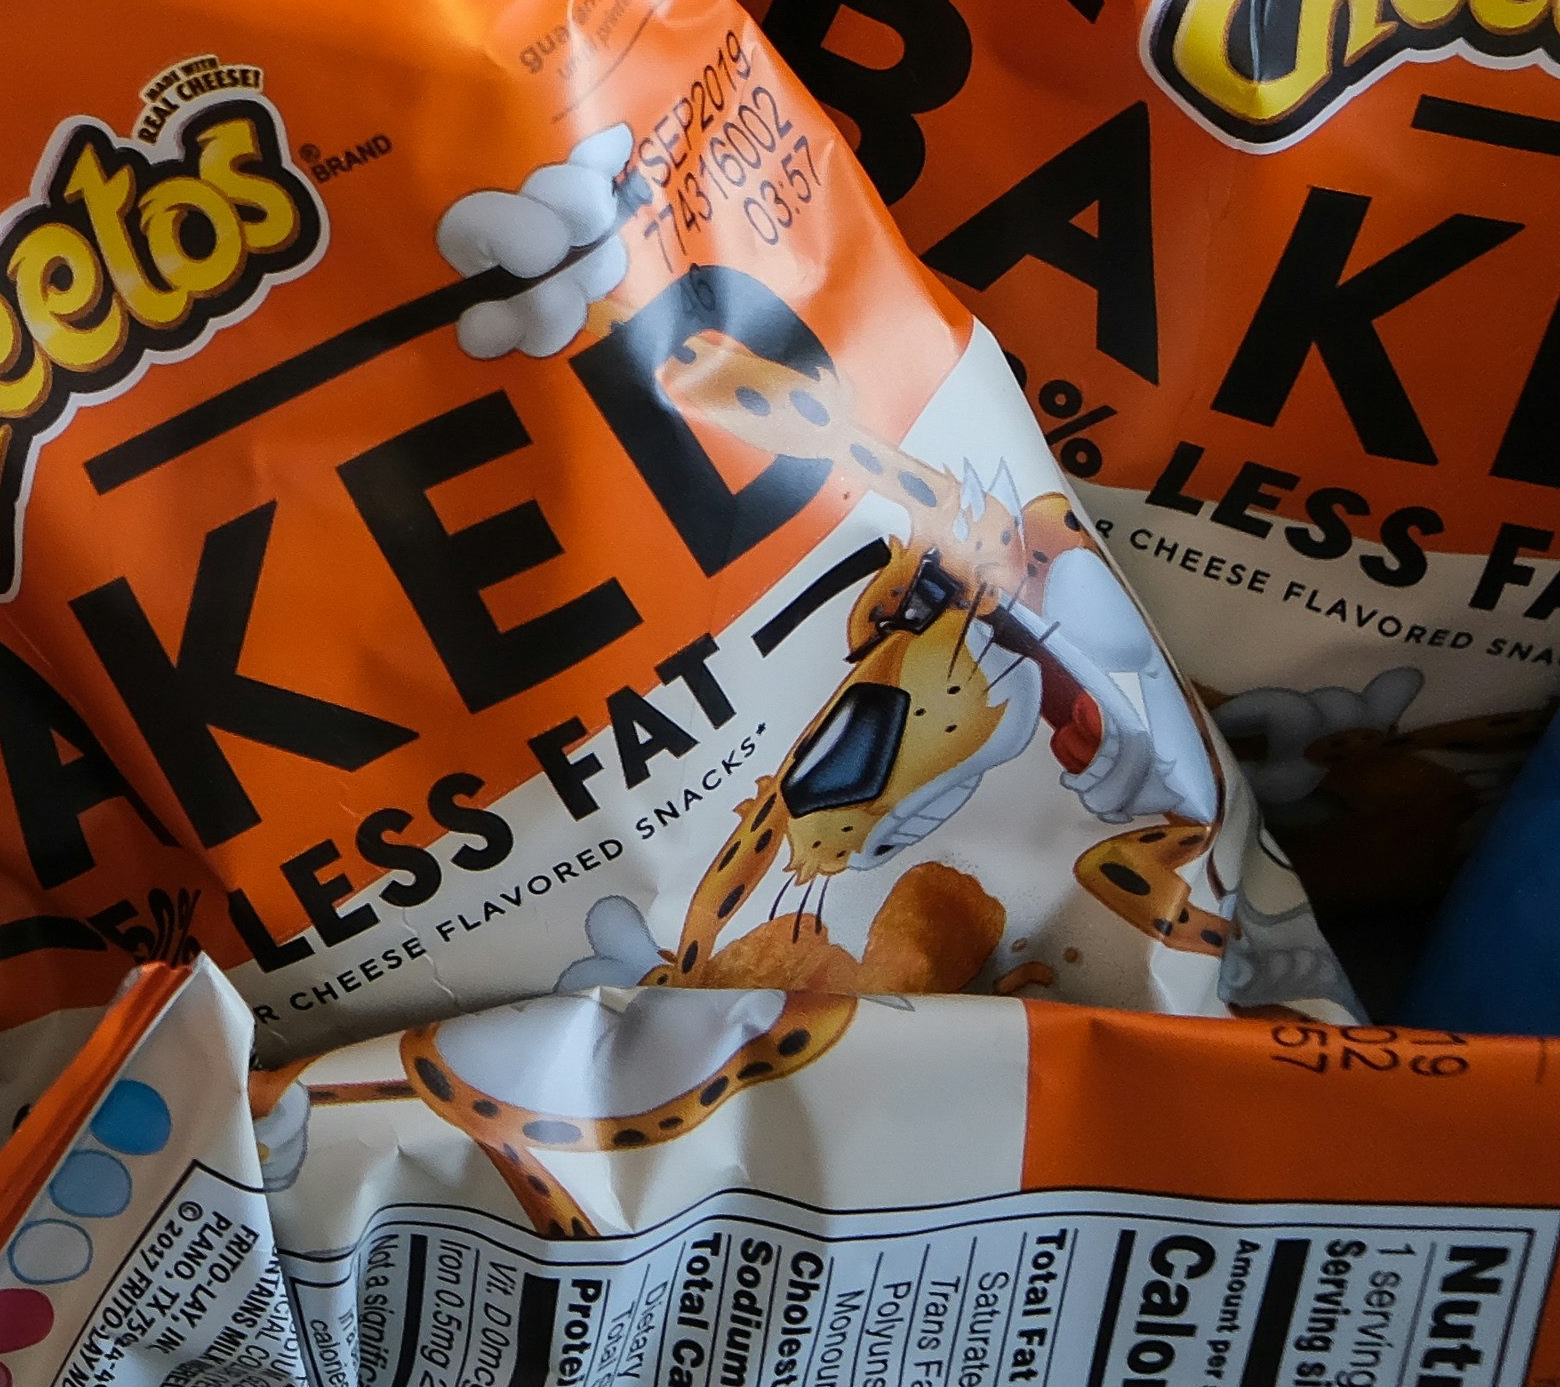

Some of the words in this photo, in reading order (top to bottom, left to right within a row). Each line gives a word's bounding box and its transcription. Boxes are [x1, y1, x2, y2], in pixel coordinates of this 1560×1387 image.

[311, 134, 393, 183] BRAND
[744, 136, 822, 245] 03:57
[1143, 442, 1446, 589] LESS
[1129, 528, 1268, 594] CHEESE
[1282, 582, 1476, 651] FLAVORED
[230, 772, 513, 973] LESS
[526, 632, 754, 823] FAT
[290, 939, 430, 1014] CHEESE
[433, 832, 625, 943] FLAVORED
